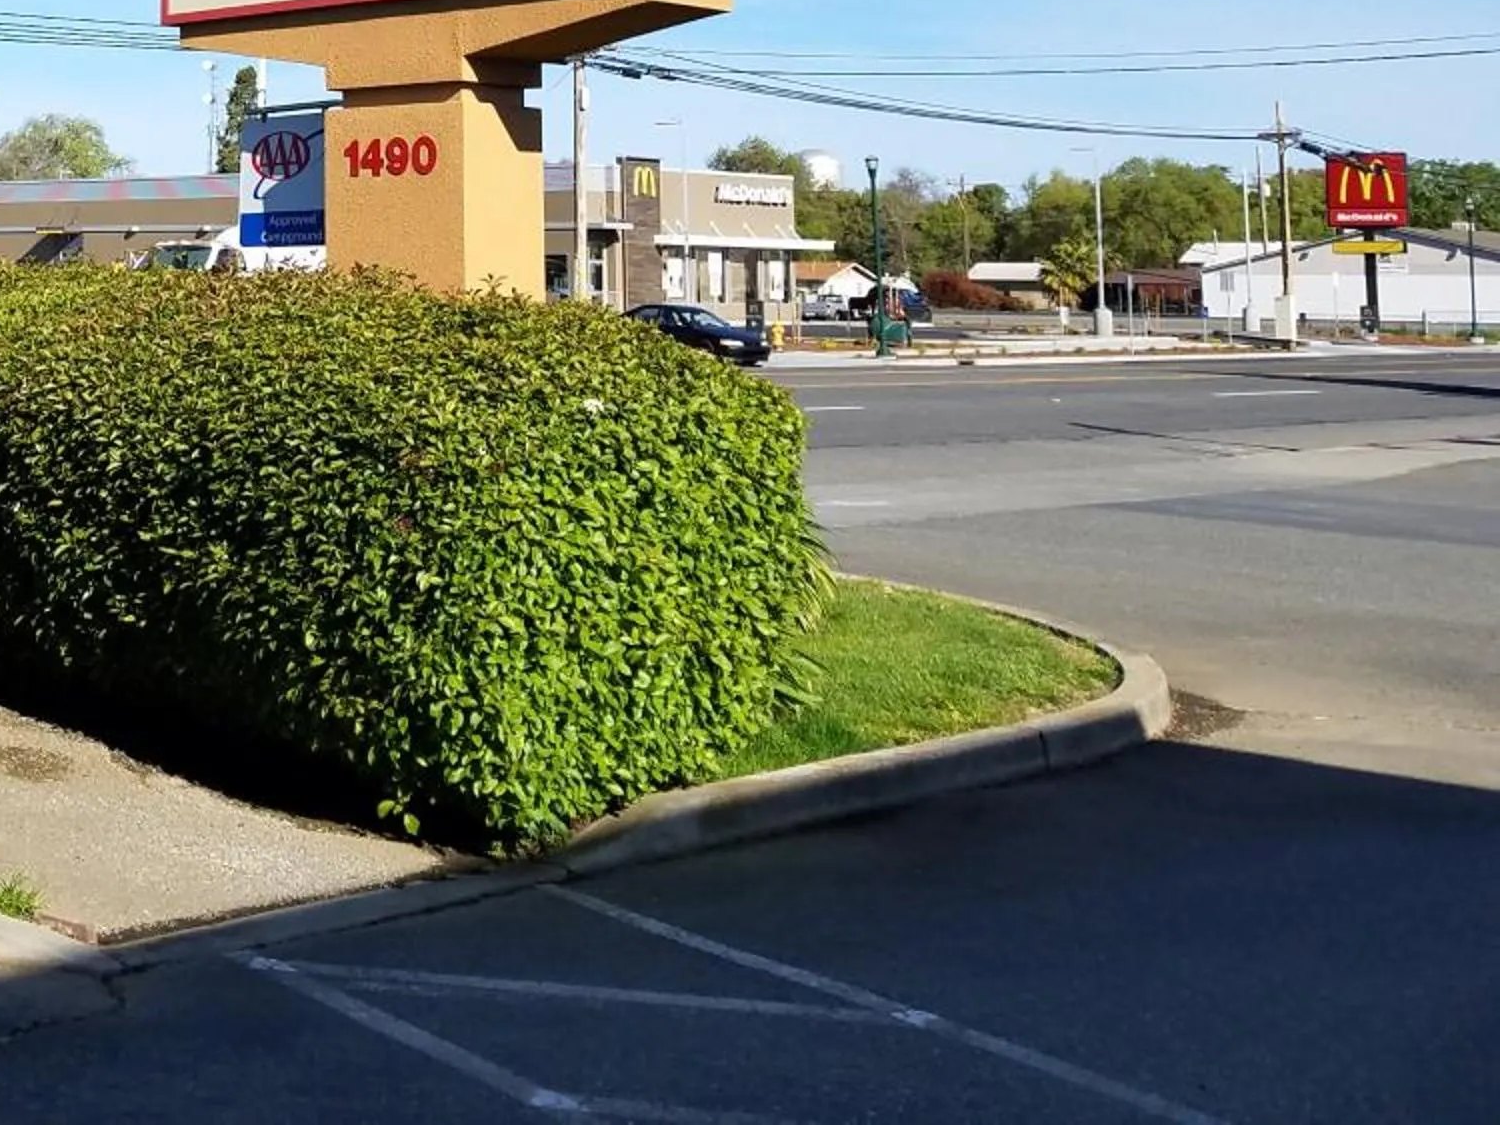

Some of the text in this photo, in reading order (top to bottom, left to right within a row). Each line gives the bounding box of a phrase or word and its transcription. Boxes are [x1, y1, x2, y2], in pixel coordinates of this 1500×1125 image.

[258, 132, 303, 179] AAA
[343, 134, 438, 178] 1490
[268, 214, 317, 228] Approved
